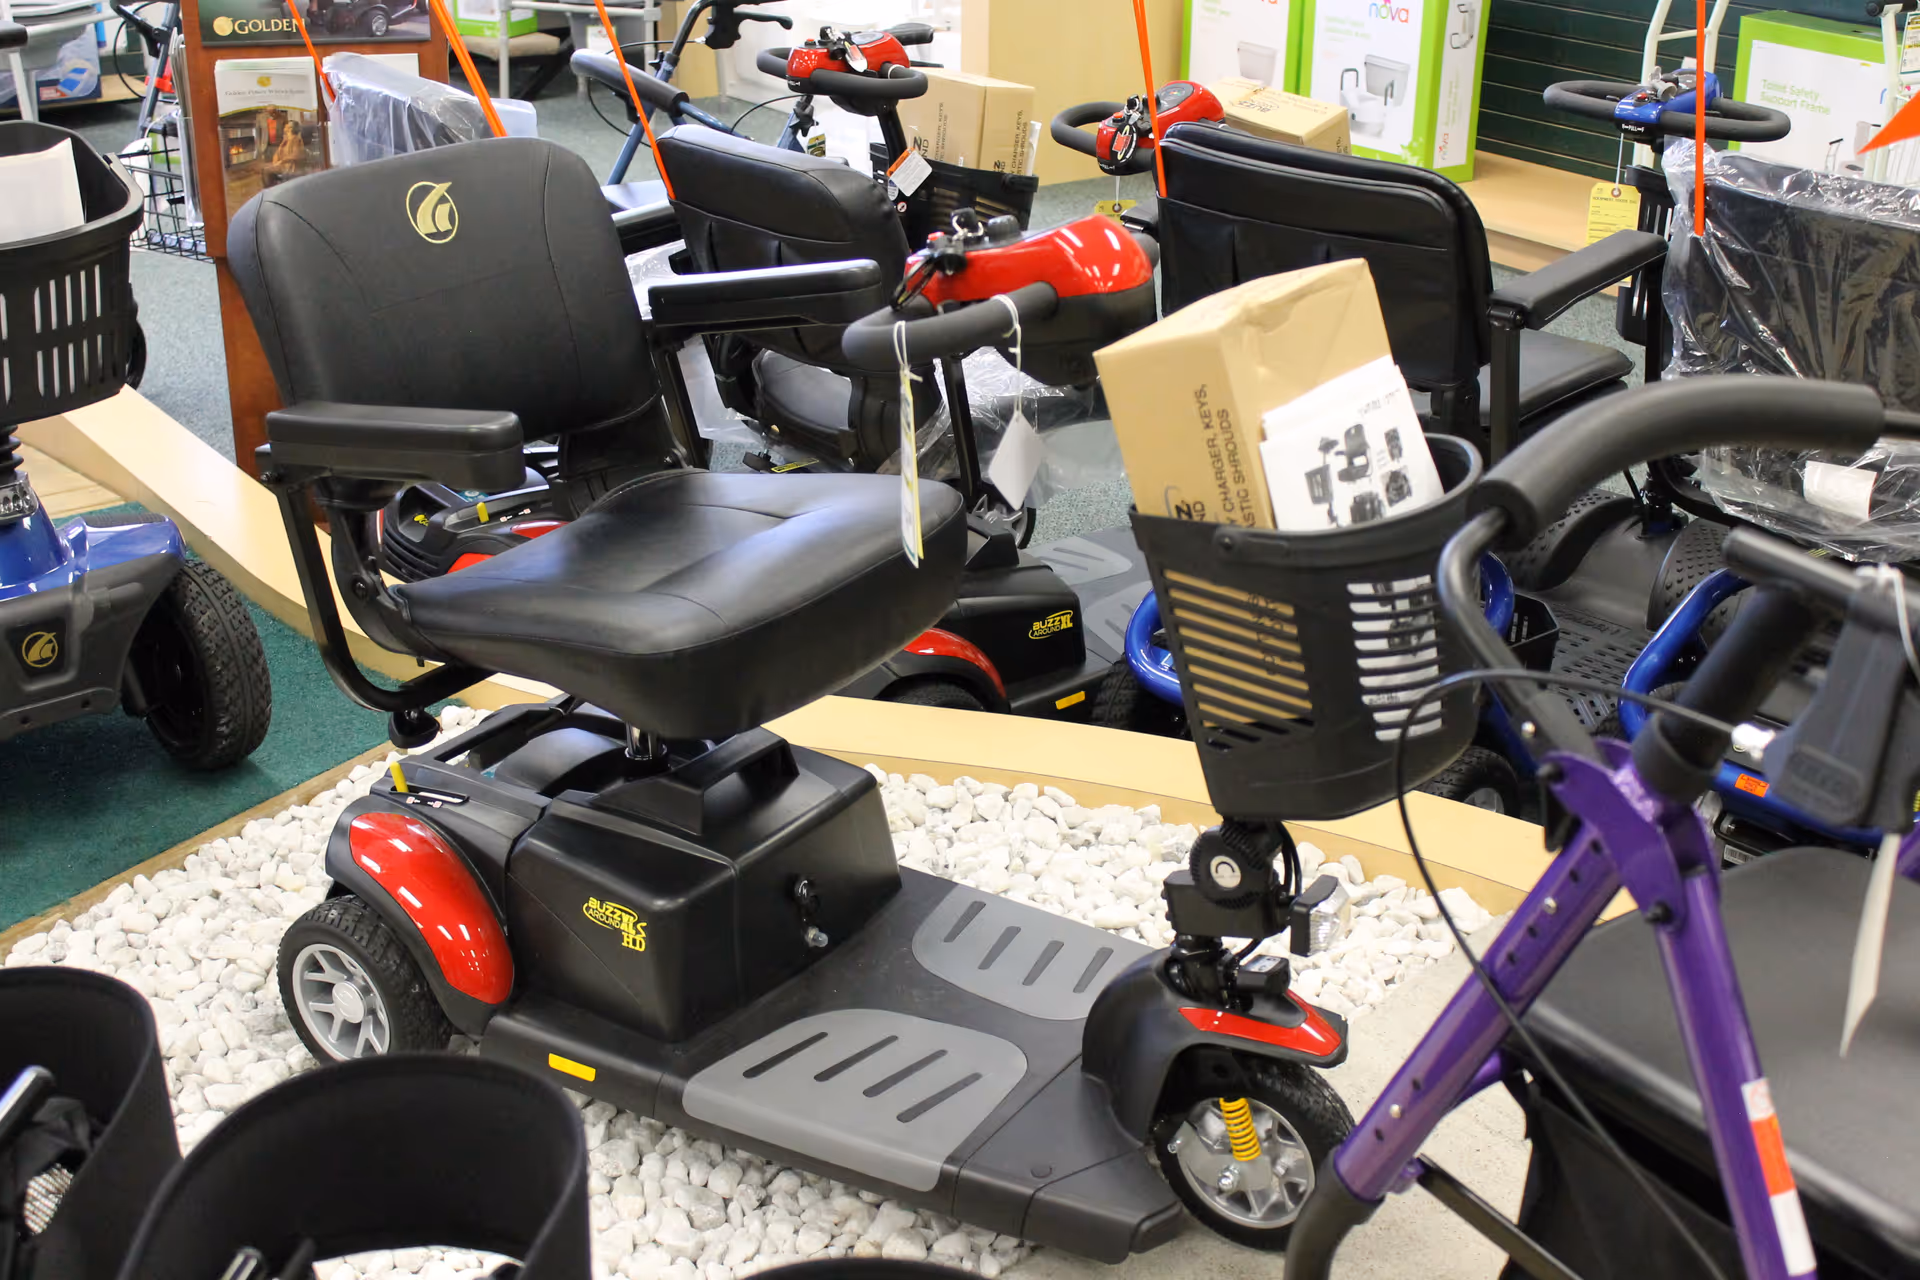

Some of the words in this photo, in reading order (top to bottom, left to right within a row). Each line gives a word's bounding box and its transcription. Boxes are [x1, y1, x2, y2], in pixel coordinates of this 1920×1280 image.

[1369, 3, 1409, 23] nova
[234, 19, 305, 34] GOLDEN
[1789, 85, 1820, 101] Safety
[1800, 101, 1830, 115] Frame
[1194, 383, 1213, 431] KEYS,
[1217, 408, 1246, 485] SHROUDS
[1033, 616, 1061, 631] BUZZ
[1060, 614, 1073, 630] XL
[1033, 625, 1060, 637] AROUND
[588, 896, 622, 921] BUZZ
[588, 908, 620, 929] AROUND
[621, 931, 646, 952] HD
